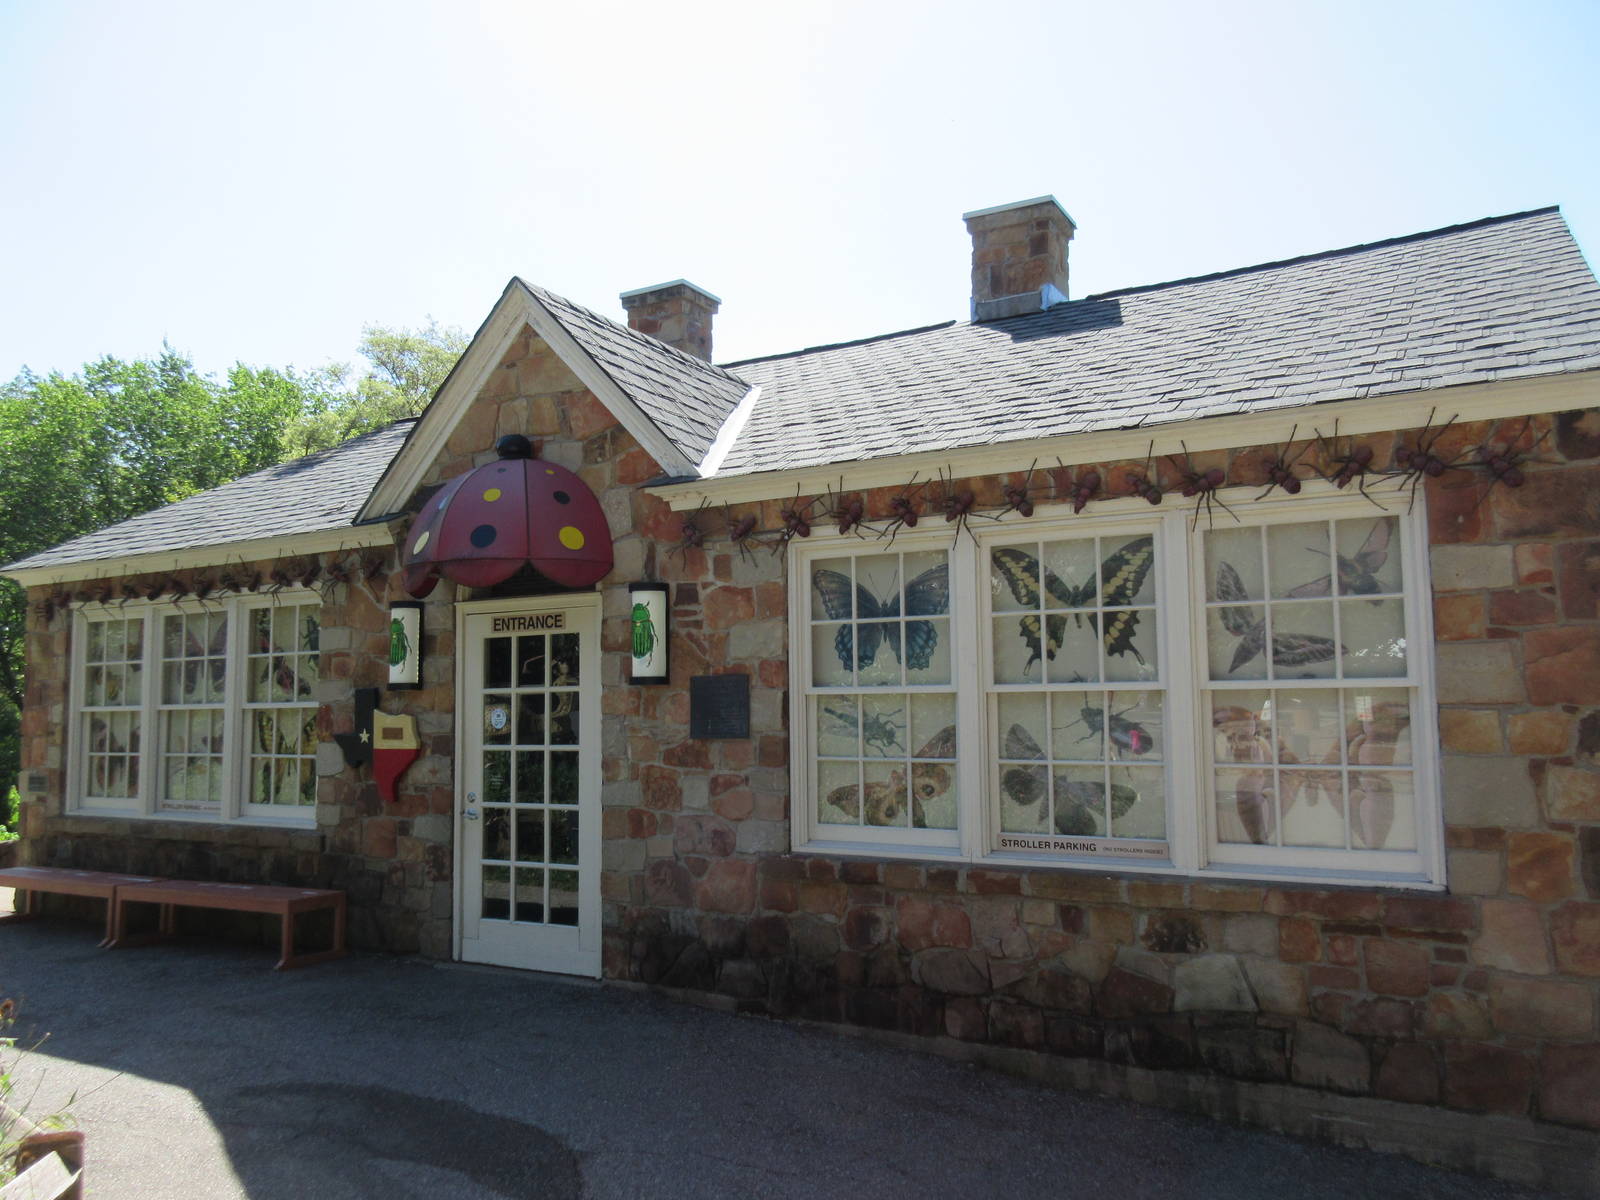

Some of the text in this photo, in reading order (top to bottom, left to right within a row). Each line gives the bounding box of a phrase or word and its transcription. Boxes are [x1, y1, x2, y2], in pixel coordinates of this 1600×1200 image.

[493, 614, 563, 632] ENTRANCE
[1001, 838, 1097, 852] STROLLER PARKING
